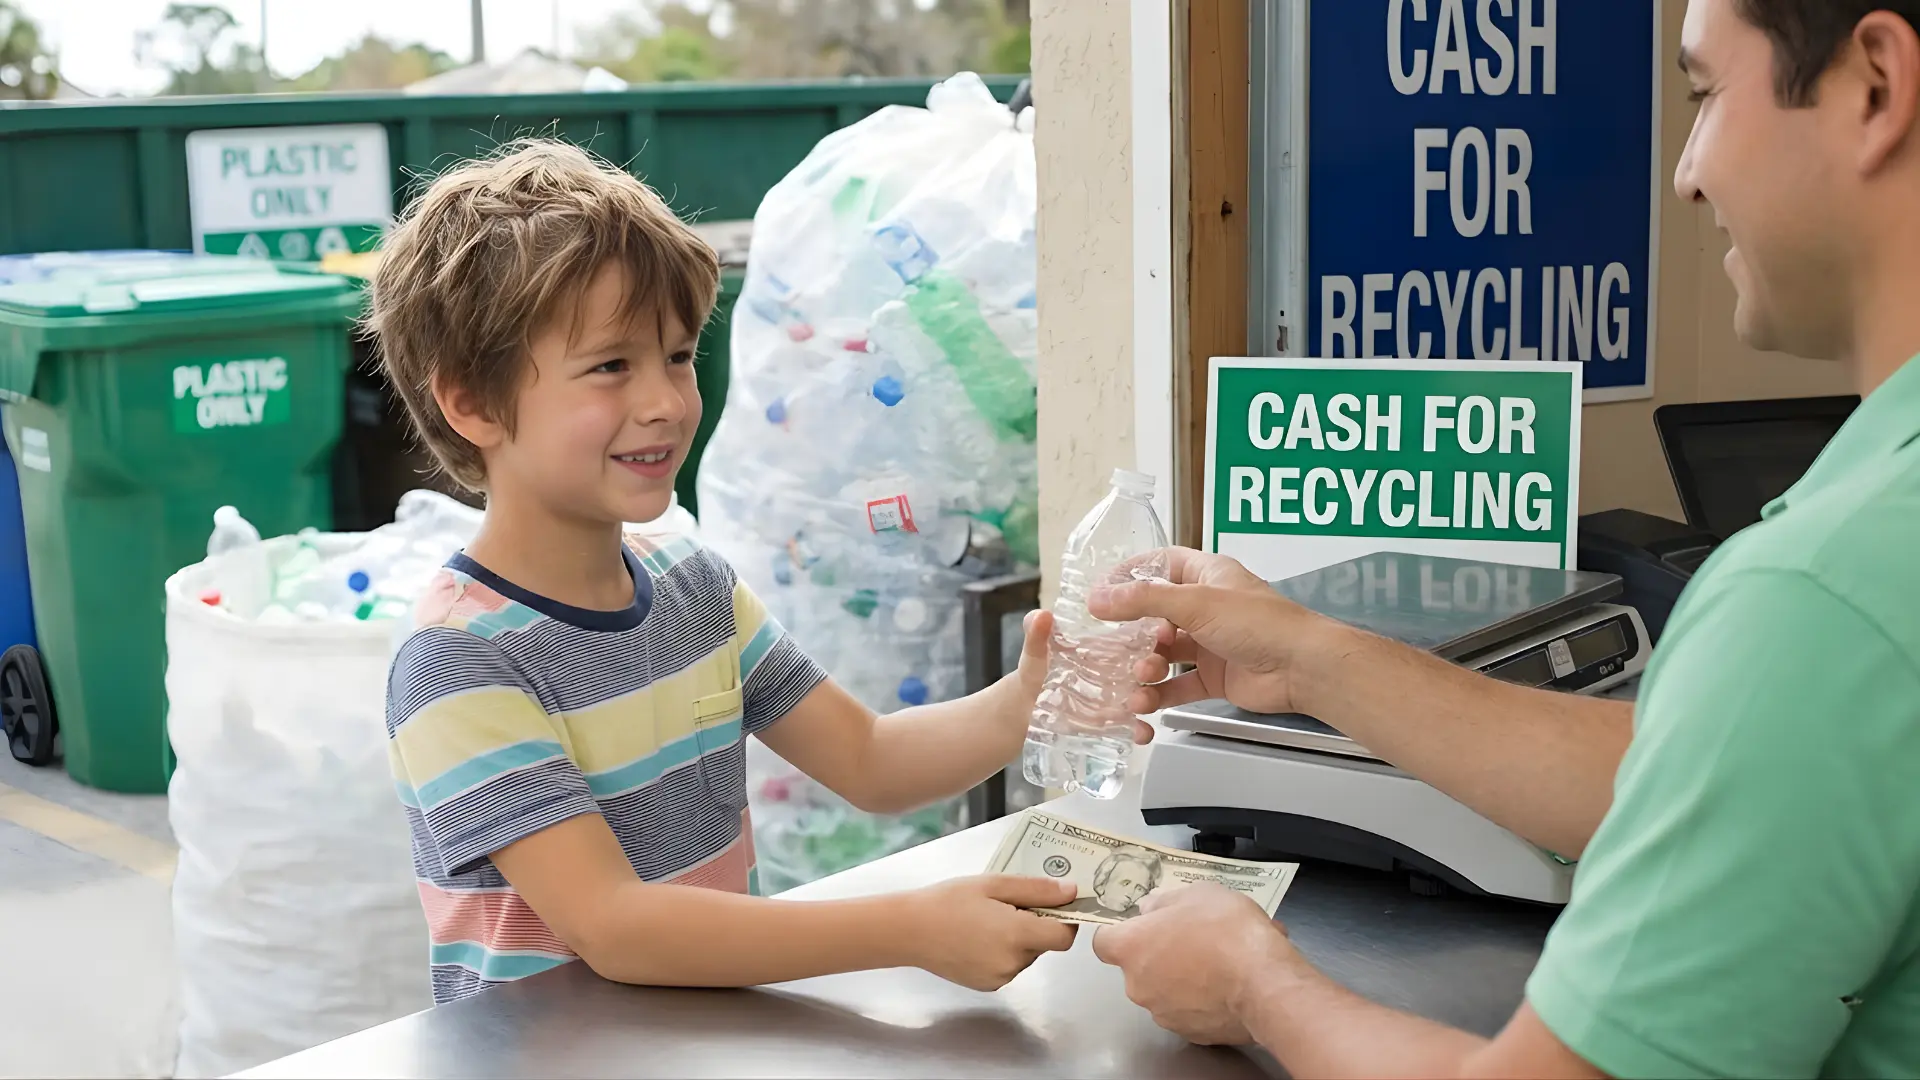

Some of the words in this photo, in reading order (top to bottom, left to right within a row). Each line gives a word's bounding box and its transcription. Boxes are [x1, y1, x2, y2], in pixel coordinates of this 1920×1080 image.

[1387, 0, 1557, 95] CASH
[221, 143, 357, 179] PLASTIC
[1414, 126, 1533, 237] FOR
[251, 184, 332, 218] ONLY
[1321, 262, 1630, 361] RECYCLING
[173, 357, 288, 399] PLASTIC
[197, 394, 267, 429] ONLY
[1248, 391, 1401, 451] CASH
[1423, 395, 1536, 454] FOR
[1228, 466, 1552, 531] RECYCLING
